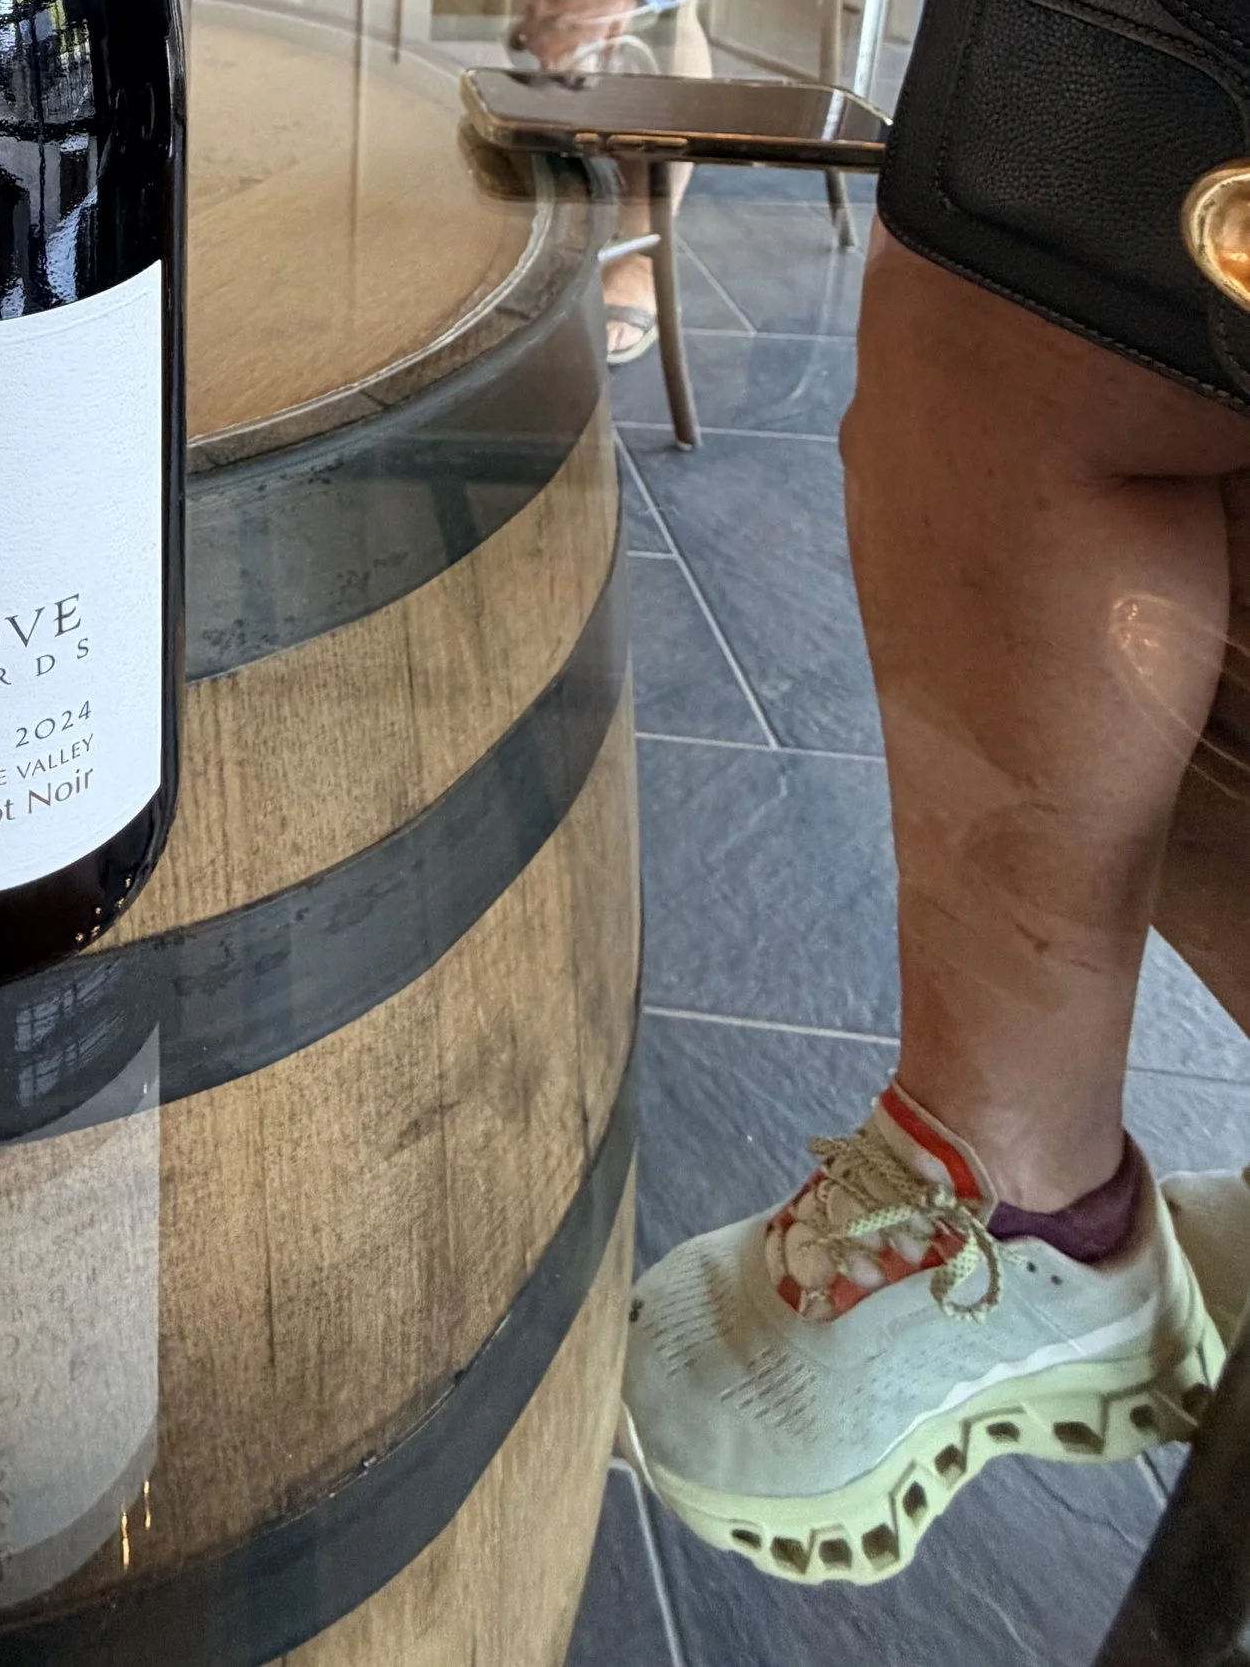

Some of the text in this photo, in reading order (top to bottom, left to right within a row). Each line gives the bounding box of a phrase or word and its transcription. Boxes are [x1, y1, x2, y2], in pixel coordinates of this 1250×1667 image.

[15, 700, 92, 748] 2024
[16, 733, 94, 780] VALLEY
[27, 767, 94, 815] Noir
